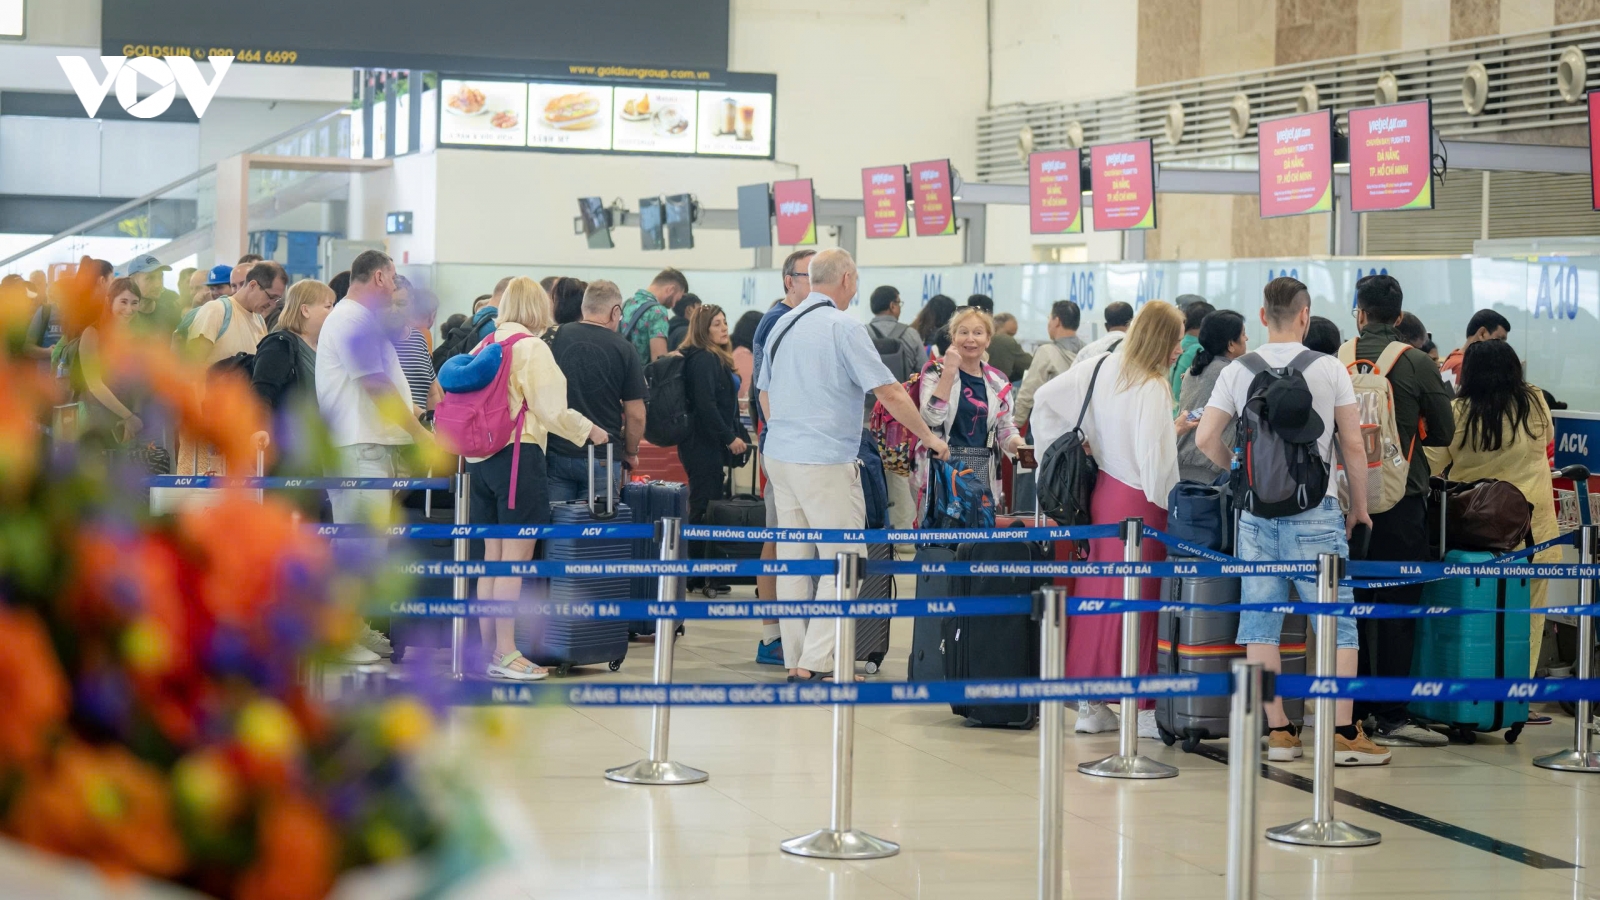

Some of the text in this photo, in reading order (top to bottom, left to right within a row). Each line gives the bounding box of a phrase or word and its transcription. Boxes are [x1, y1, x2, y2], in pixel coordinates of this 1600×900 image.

[123, 45, 190, 58] GOLDSUN
[237, 50, 261, 62] 464
[264, 51, 298, 64] 6699
[569, 66, 710, 80] www.goldsungroup.com.vn
[1070, 272, 1094, 310] A06
[1534, 265, 1578, 320] A10
[451, 527, 472, 535] ACV
[518, 528, 538, 536] ACV
[582, 528, 602, 536] ACV
[712, 529, 744, 538] KHÔNG
[747, 529, 774, 539] QUỐC
[776, 530, 788, 539] TẾ
[789, 532, 804, 542] NỘI
[920, 532, 989, 540] INTERNATIONAL
[992, 530, 1028, 538] AIRPORT
[428, 562, 441, 574] TẾ
[444, 564, 464, 576] NỘI
[511, 565, 537, 574] N.I.A
[565, 564, 602, 574] NOIBAI
[605, 564, 689, 573] INTERNATIONAL
[692, 564, 737, 573] AIRPORT
[763, 564, 788, 573] N.I.A
[922, 565, 946, 573] N.I.A
[1033, 564, 1068, 574] KHÔNG
[1070, 563, 1100, 574] QUỐC
[1102, 563, 1115, 574] TẾ
[1116, 564, 1132, 576] NỘI
[1174, 566, 1197, 574] N.I.A
[1221, 565, 1254, 574] NOIBAI
[1400, 566, 1422, 574] N.I.A
[1503, 566, 1535, 576] KHÔNG
[1537, 565, 1564, 576] QUỐC
[1566, 565, 1578, 576] TẾ
[1580, 566, 1596, 578] NỘI
[648, 604, 677, 616] N.I.A
[708, 604, 749, 616] NOIBAI
[753, 604, 844, 616] INTERNATIONAL
[848, 603, 898, 614] AIRPORT
[928, 602, 955, 613] N.I.A
[1078, 602, 1104, 611] ACV
[892, 686, 928, 700] N.I.A
[965, 684, 1016, 699] NOIBAI
[1020, 682, 1134, 698] INTERNATIONAL
[1138, 678, 1199, 694] AIRPORT
[1310, 680, 1538, 698] ACV ACV ACV
